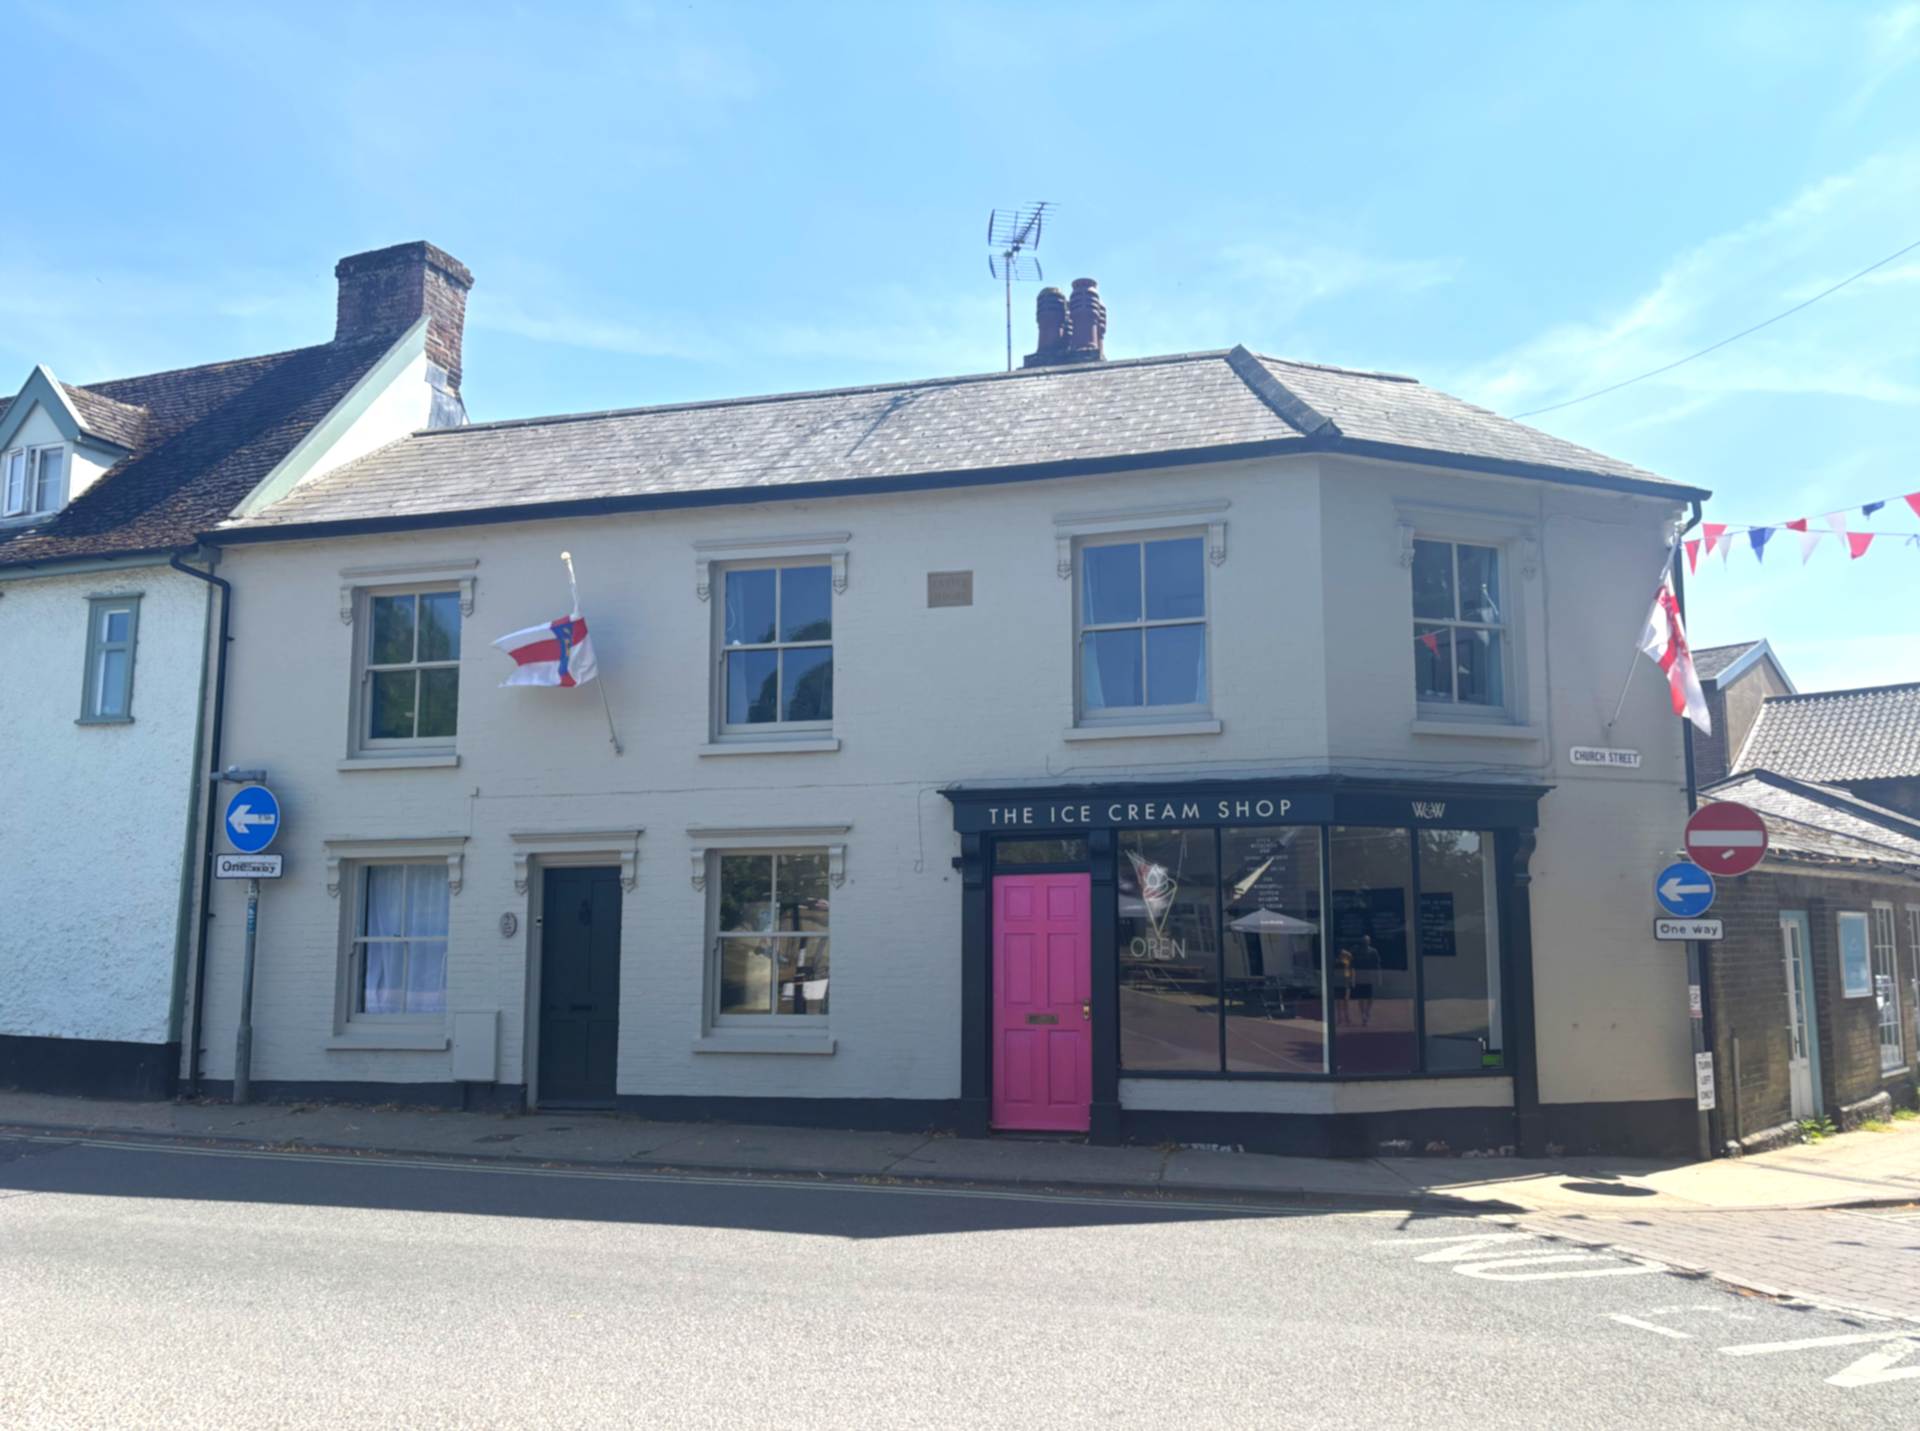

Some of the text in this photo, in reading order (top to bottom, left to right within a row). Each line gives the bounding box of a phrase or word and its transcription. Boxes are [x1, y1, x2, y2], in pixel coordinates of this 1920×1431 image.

[1574, 750, 1639, 764] CHURCH STREET
[989, 799, 1292, 825] THE ICE CREAM SHOP
[222, 861, 250, 872] One
[1660, 923, 1719, 936] One way
[1130, 936, 1186, 959] OPEN
